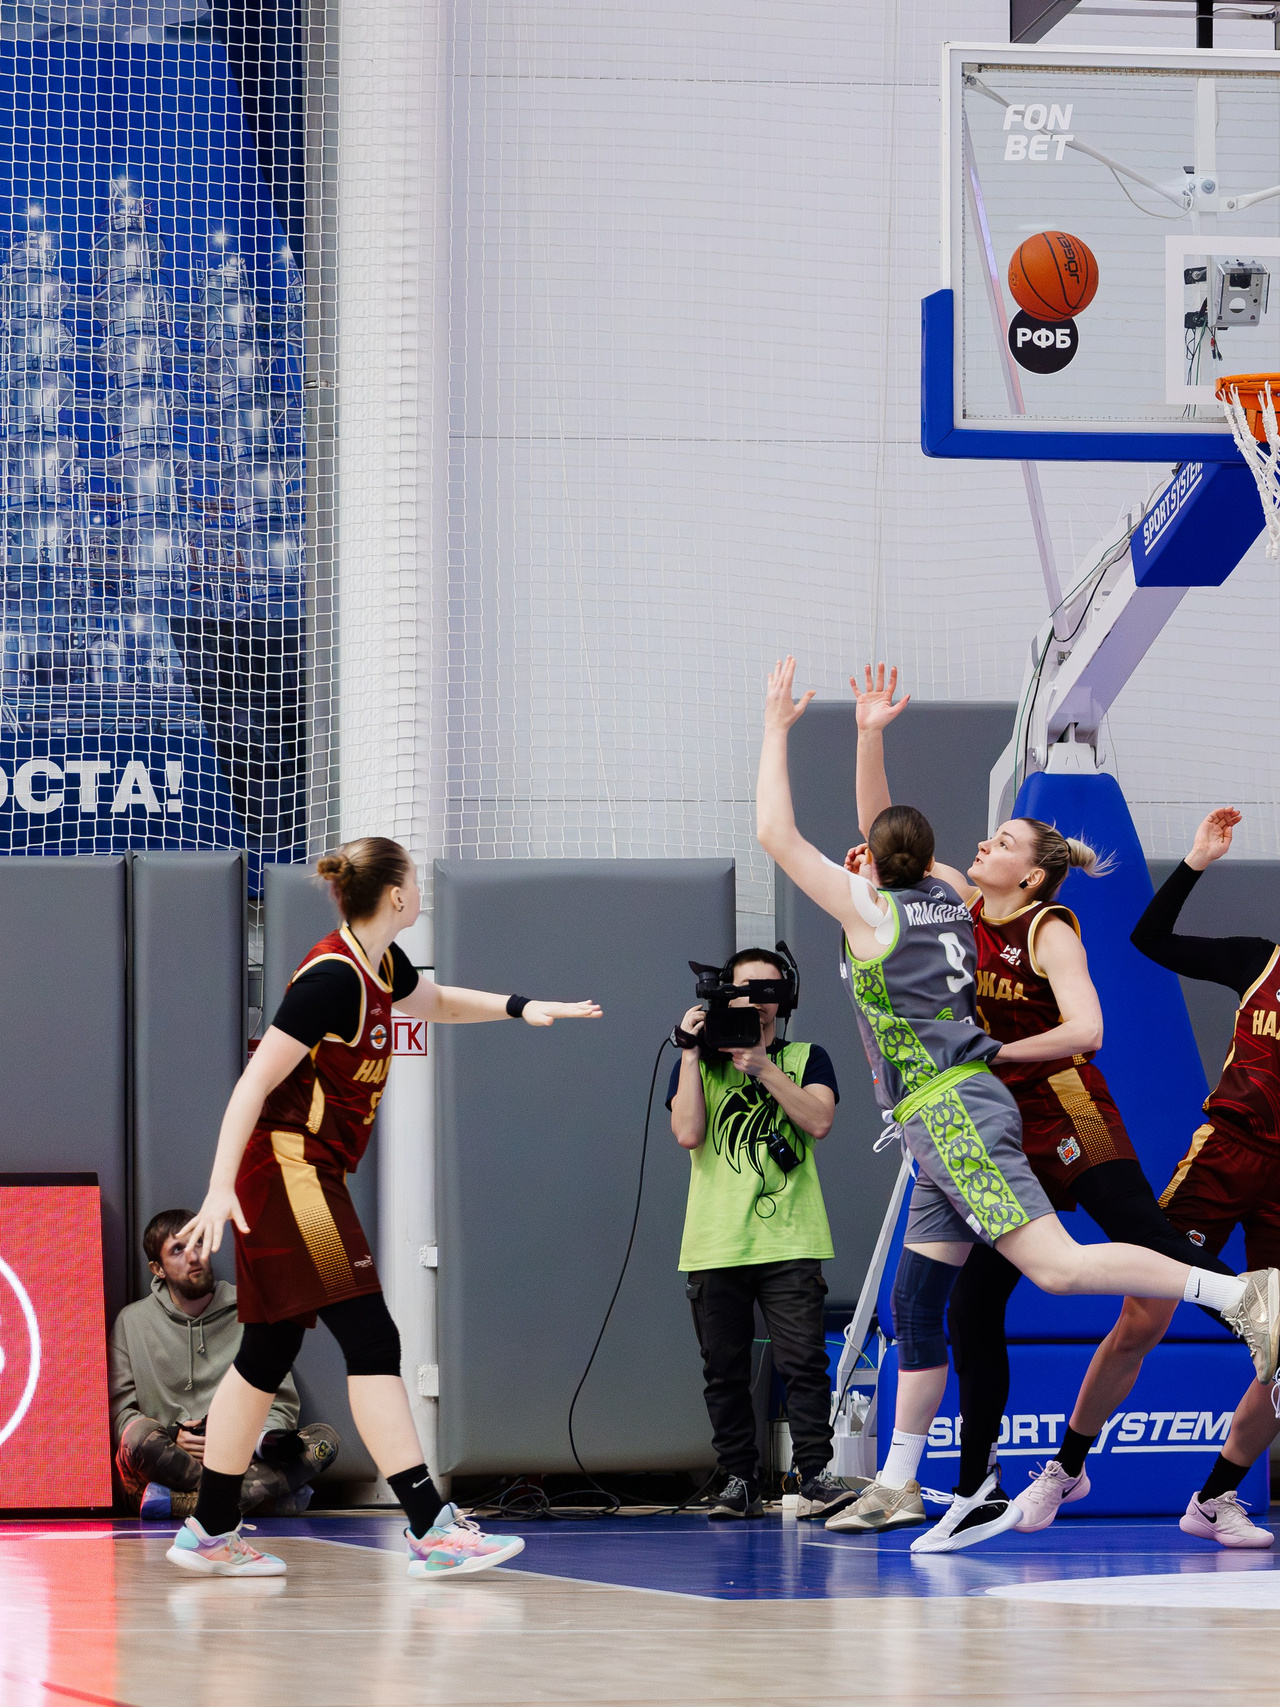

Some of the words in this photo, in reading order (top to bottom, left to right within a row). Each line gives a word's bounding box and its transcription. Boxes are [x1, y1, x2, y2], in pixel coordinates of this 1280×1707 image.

[1003, 103, 1073, 131] FON
[1004, 134, 1074, 161] BET
[1016, 327, 1072, 349] РФБ
[0, 760, 182, 814] СТА!
